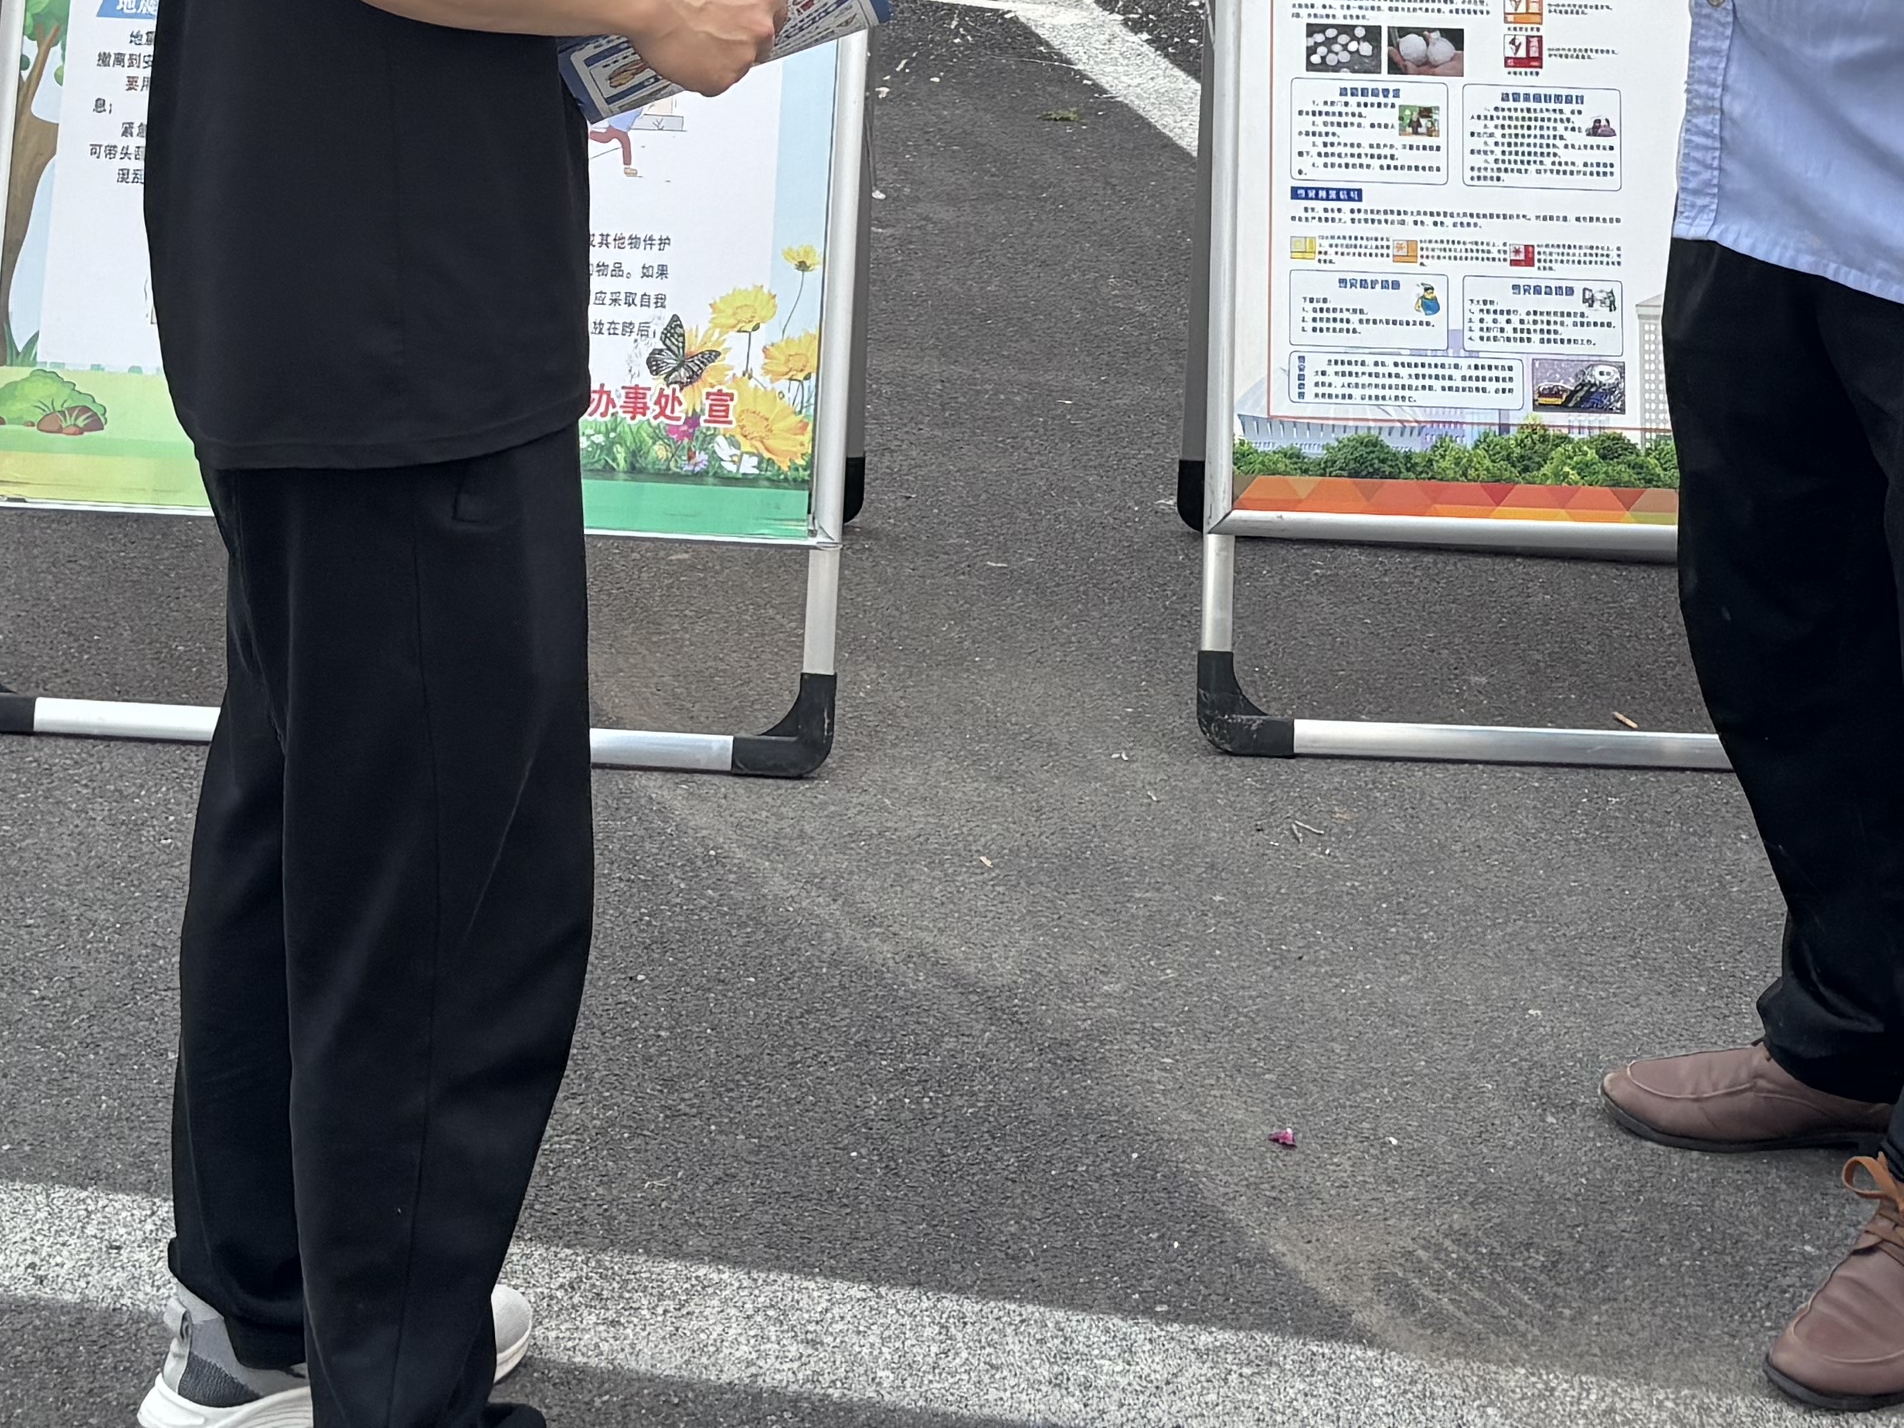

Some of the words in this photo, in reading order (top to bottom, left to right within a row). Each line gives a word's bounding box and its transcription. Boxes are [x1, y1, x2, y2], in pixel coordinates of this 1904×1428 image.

[590, 261, 670, 281] 物品。如果
[593, 290, 667, 309] 应采取自我
[587, 382, 684, 422] 办事处
[702, 388, 736, 425] 宣
